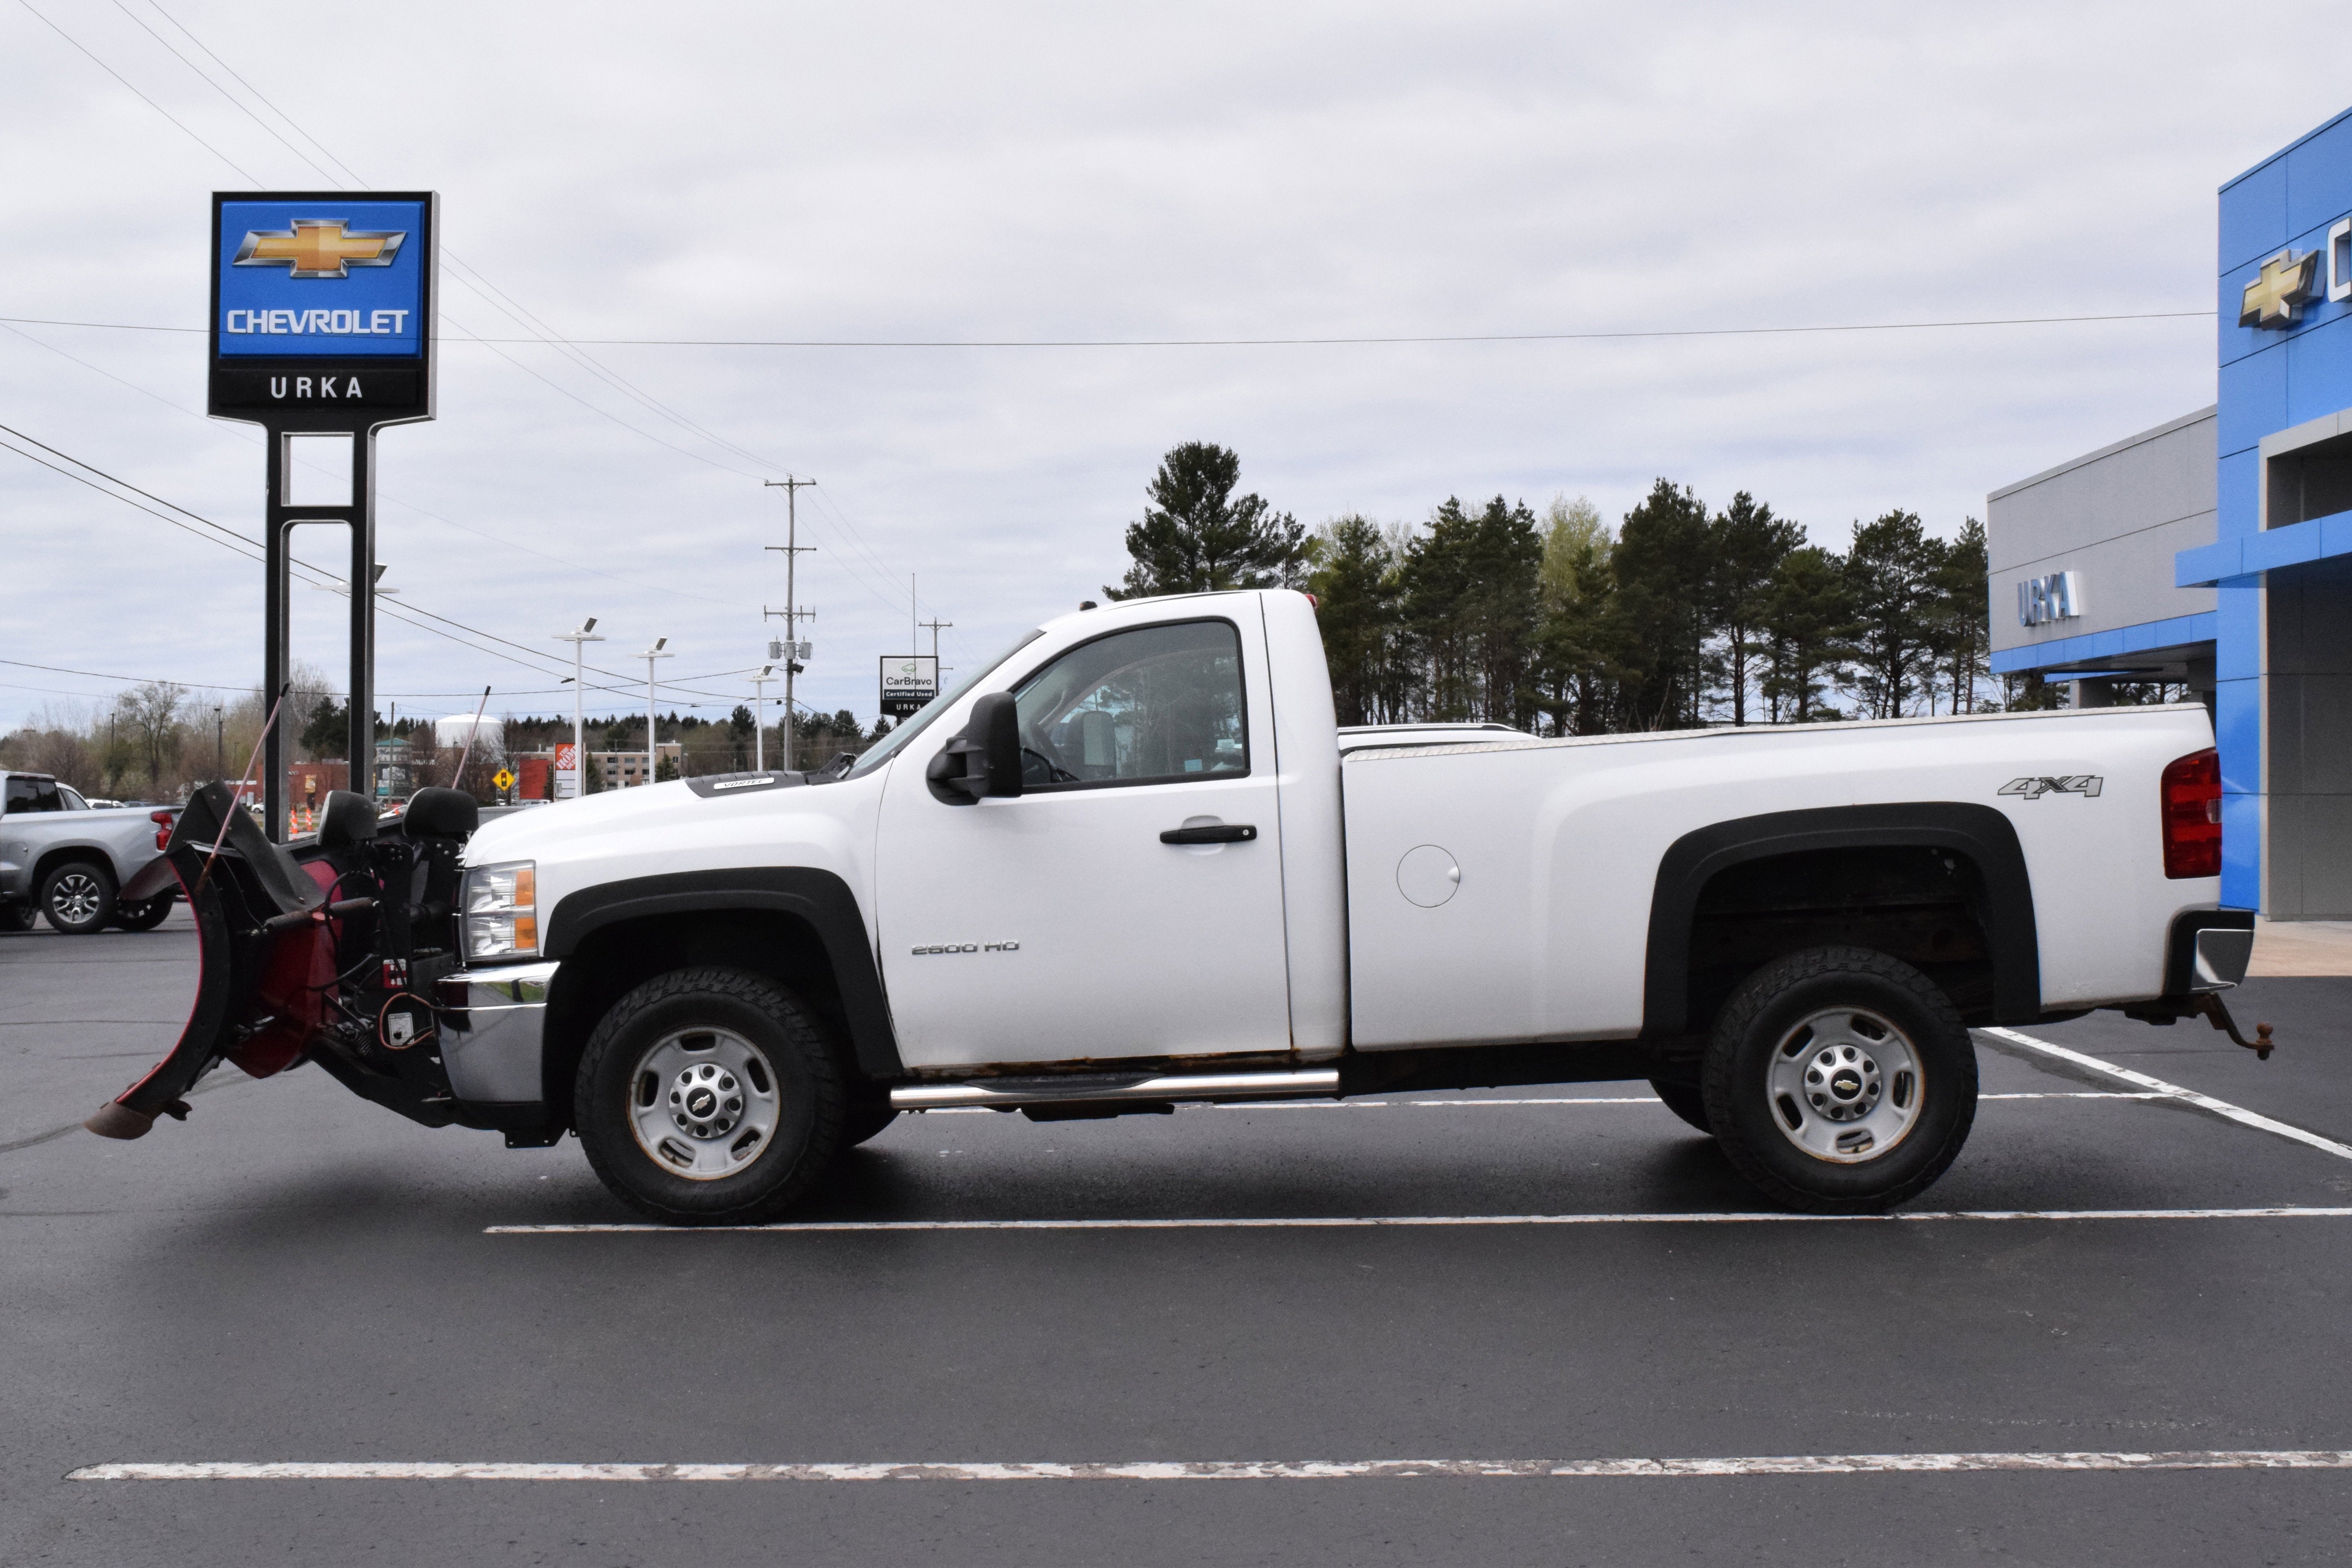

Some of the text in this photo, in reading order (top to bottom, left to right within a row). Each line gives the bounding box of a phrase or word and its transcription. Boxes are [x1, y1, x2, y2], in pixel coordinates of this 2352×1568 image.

[227, 310, 408, 334] CHEVROLET
[271, 377, 363, 398] URKA
[2018, 571, 2079, 627] URKA
[886, 677, 932, 685] CarBravo
[556, 745, 576, 769] HOM
[911, 940, 1019, 955] 2500 HD
